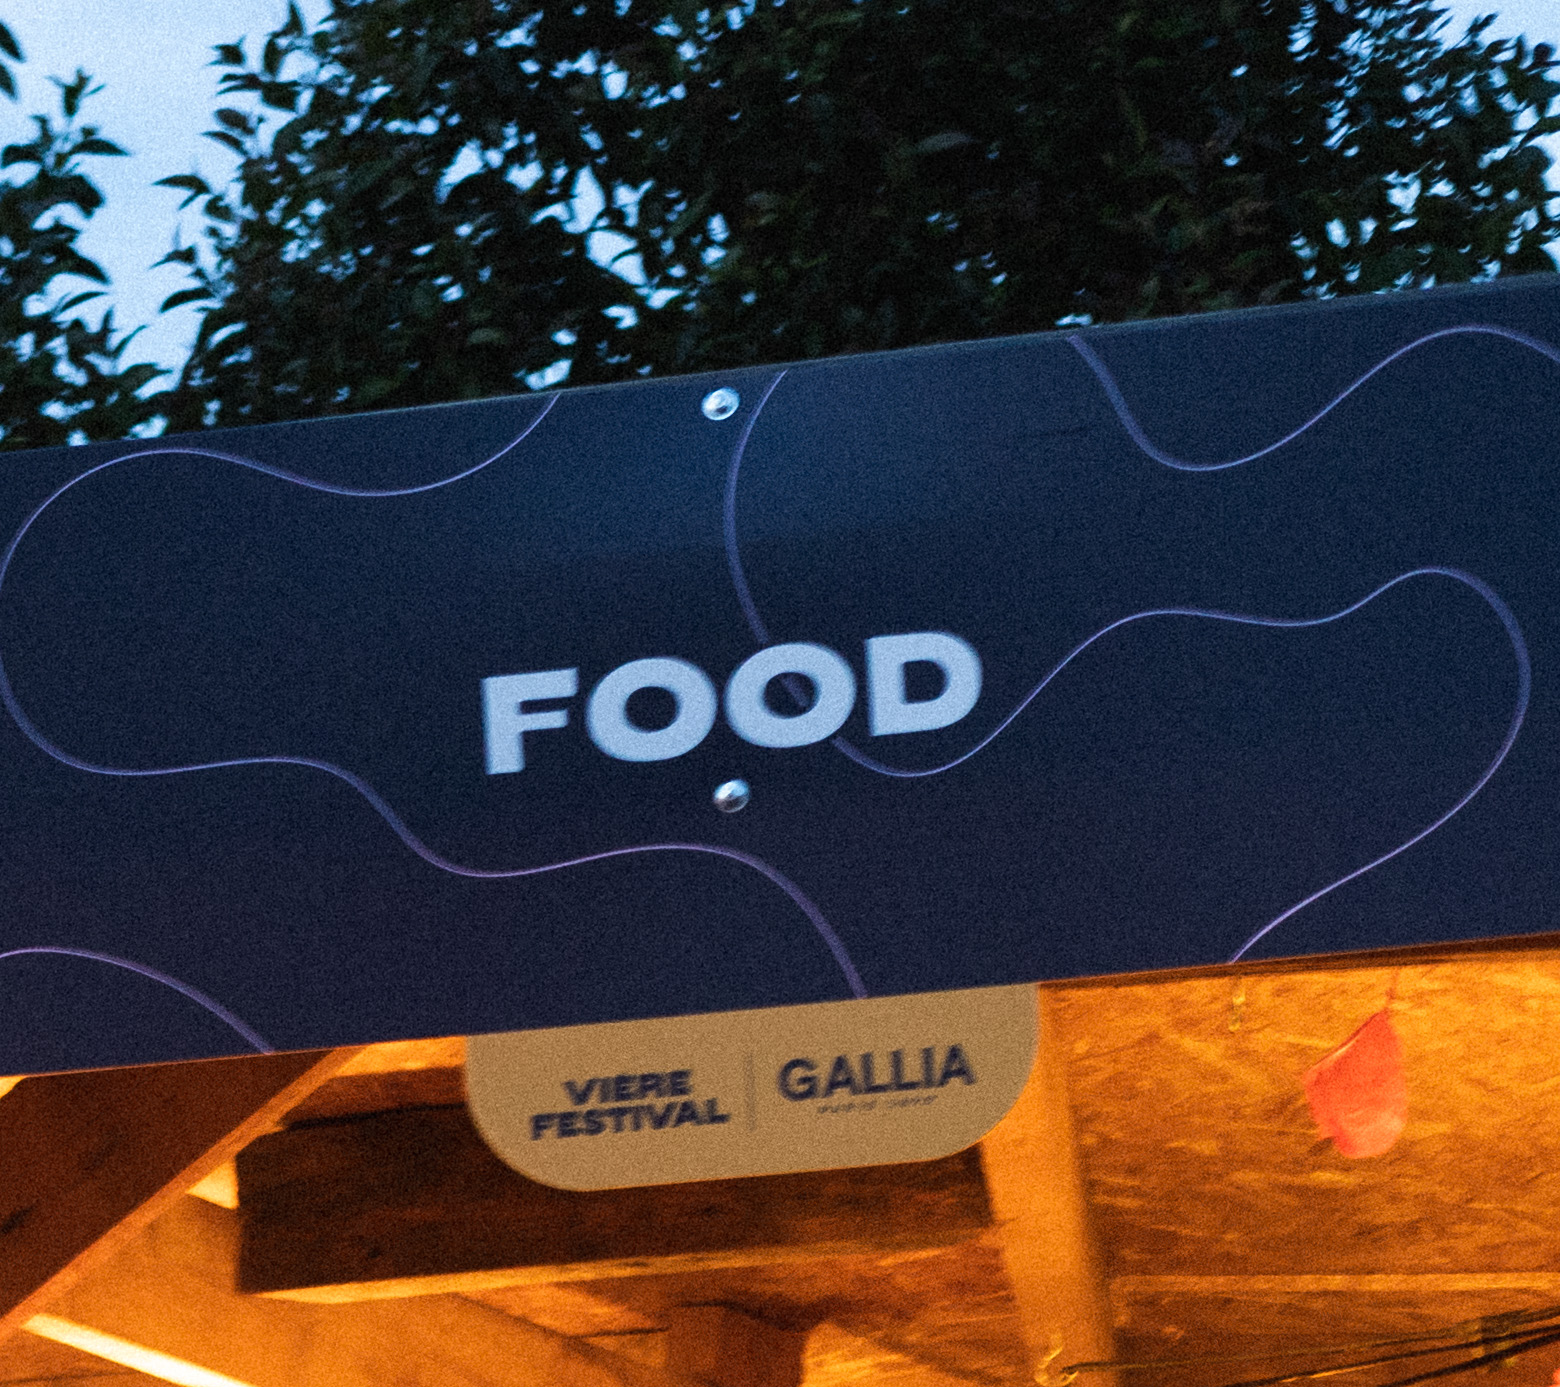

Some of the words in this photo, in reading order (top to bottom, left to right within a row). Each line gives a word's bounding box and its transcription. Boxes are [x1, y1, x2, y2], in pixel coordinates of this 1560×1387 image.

[480, 630, 983, 775] FOOD
[563, 1069, 692, 1105] VIERE
[778, 1043, 977, 1101] GALLIA
[531, 1099, 729, 1140] FESTIVAL
